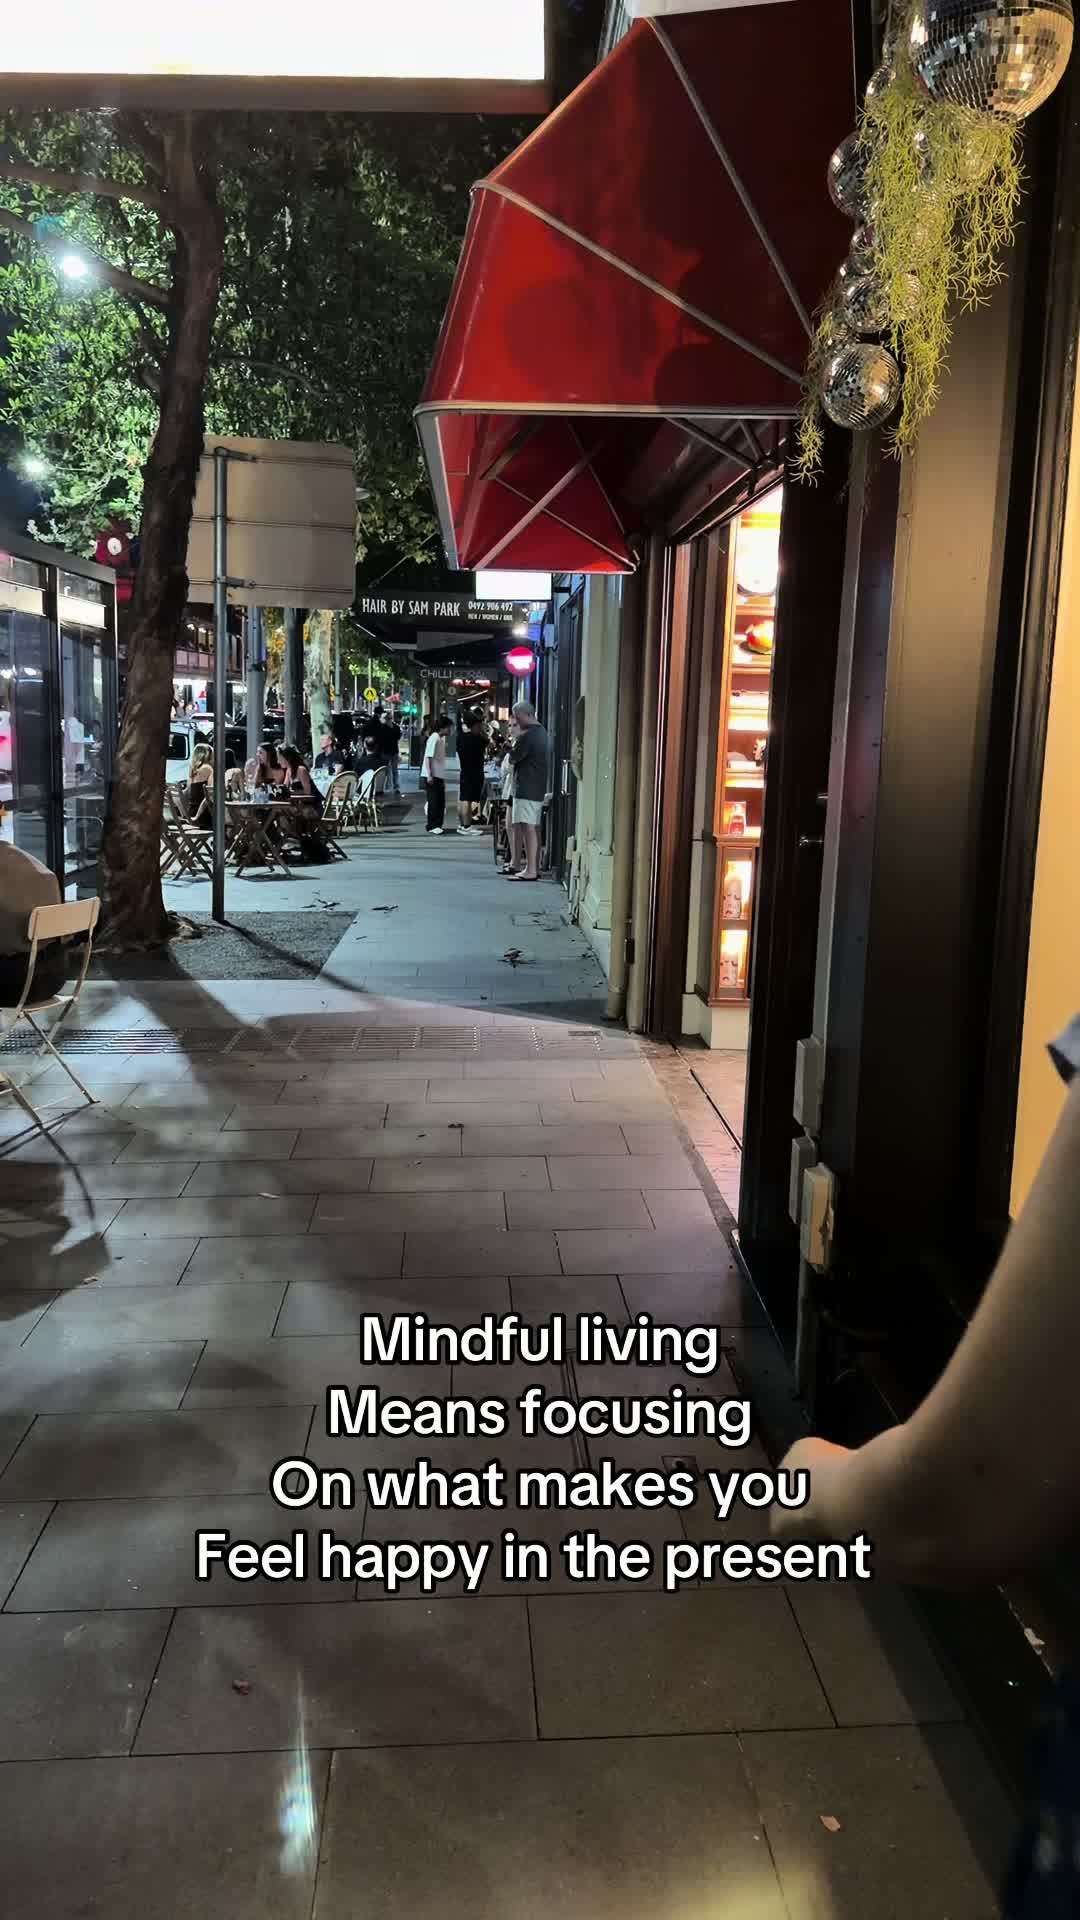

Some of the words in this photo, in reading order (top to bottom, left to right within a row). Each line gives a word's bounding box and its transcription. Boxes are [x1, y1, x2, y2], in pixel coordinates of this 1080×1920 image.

[362, 598, 387, 614] HAIR
[391, 599, 405, 615] BY
[409, 600, 429, 616] SAM
[434, 601, 460, 617] PARK
[501, 602, 513, 612] 492
